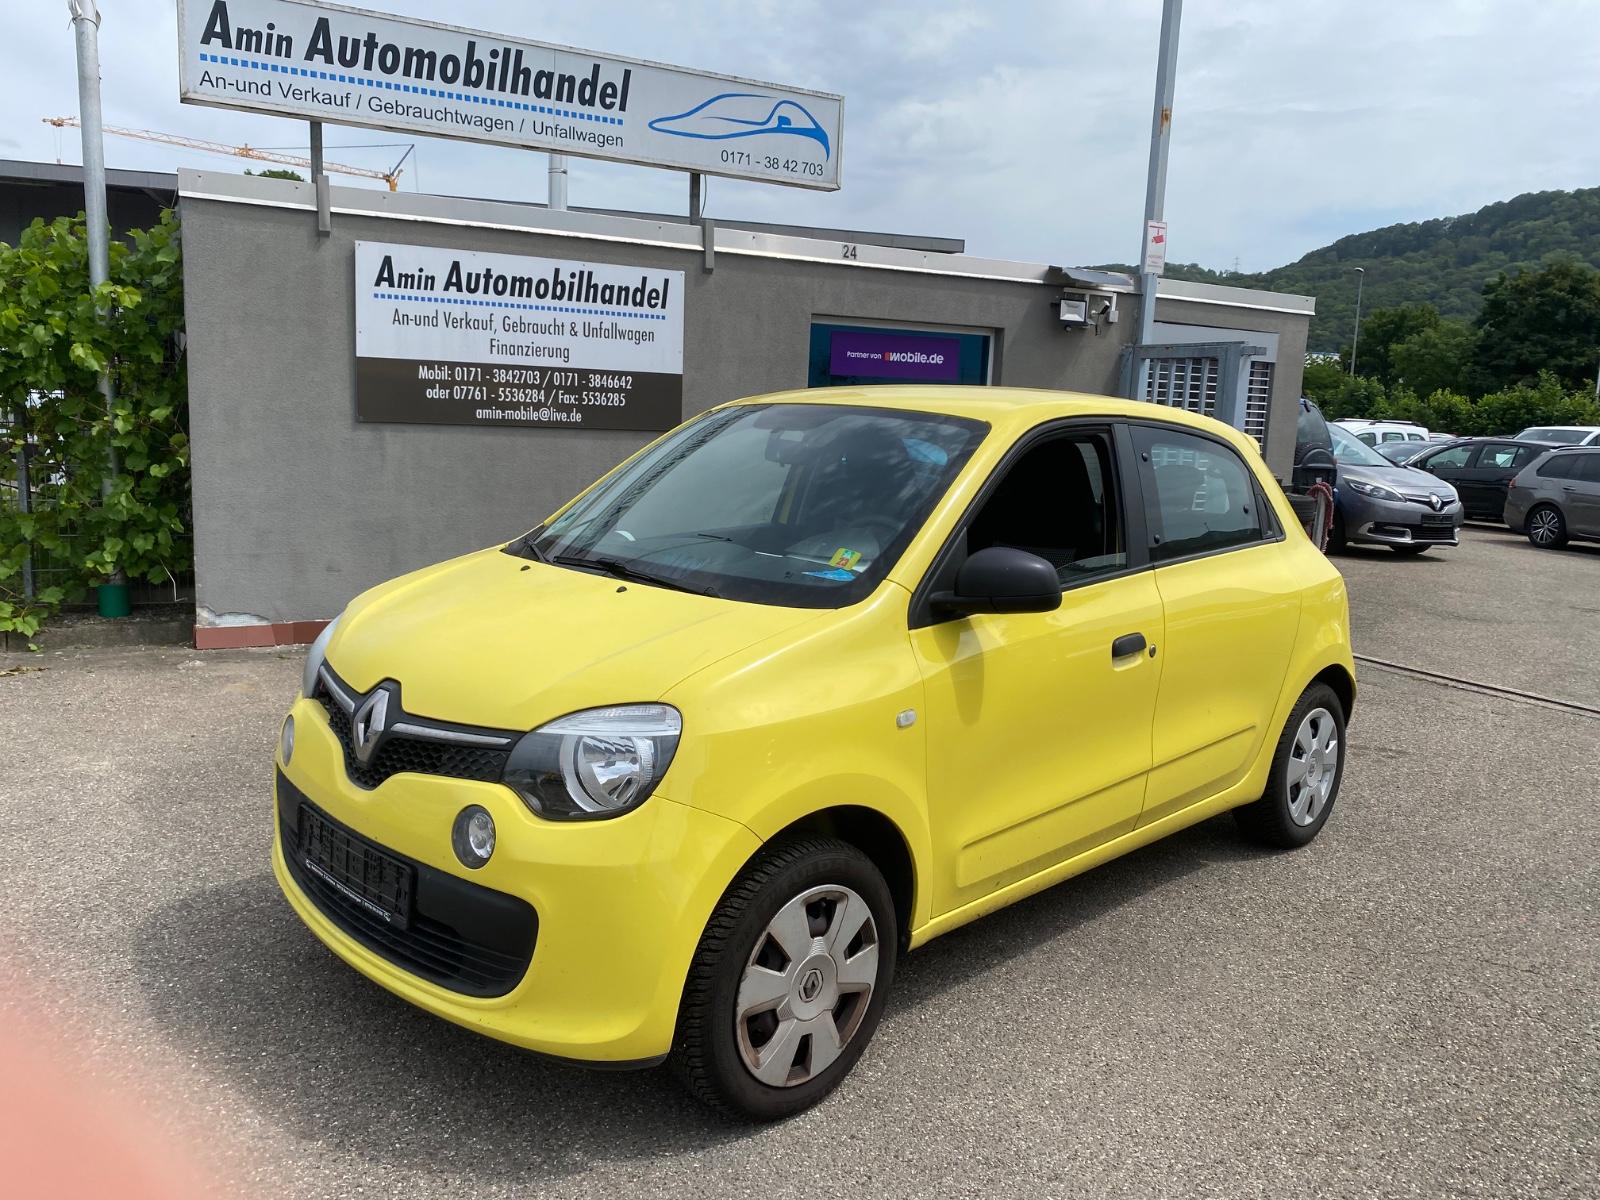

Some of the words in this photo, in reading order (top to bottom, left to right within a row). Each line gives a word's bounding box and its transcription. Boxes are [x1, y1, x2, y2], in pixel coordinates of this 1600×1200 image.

[200, 0, 293, 58] Amin
[304, 17, 632, 112] Automobilhandel
[199, 70, 272, 97] An-und
[278, 83, 352, 108] Verkauf
[368, 96, 514, 133] Gebrauchtwagen
[532, 121, 624, 148] Unfallwagen
[720, 149, 751, 166] 0171
[764, 156, 780, 171] 38
[783, 158, 799, 173] 42
[802, 161, 824, 176] 703
[842, 244, 858, 260] 24
[374, 255, 436, 291] Amin
[443, 260, 670, 310] Automobilhandel
[392, 308, 439, 328] An-und
[443, 312, 498, 335] Verkauf,
[502, 315, 566, 337] Gebraucht
[570, 322, 578, 337] &
[582, 321, 655, 345] Unfallwagen
[489, 338, 570, 363] Finanzierung
[846, 351, 869, 360] Partner
[418, 365, 452, 381] Mobil:
[455, 367, 482, 382] 0171
[493, 369, 541, 385] 3842703
[553, 372, 578, 386] 0171
[588, 374, 633, 390] 3846642
[426, 384, 451, 400] oder
[453, 385, 487, 401] 07761
[499, 388, 546, 404] 5536284
[558, 391, 579, 404] Fax:
[582, 392, 626, 407] 5536285
[476, 406, 583, 423] amin-mobile@live.de
